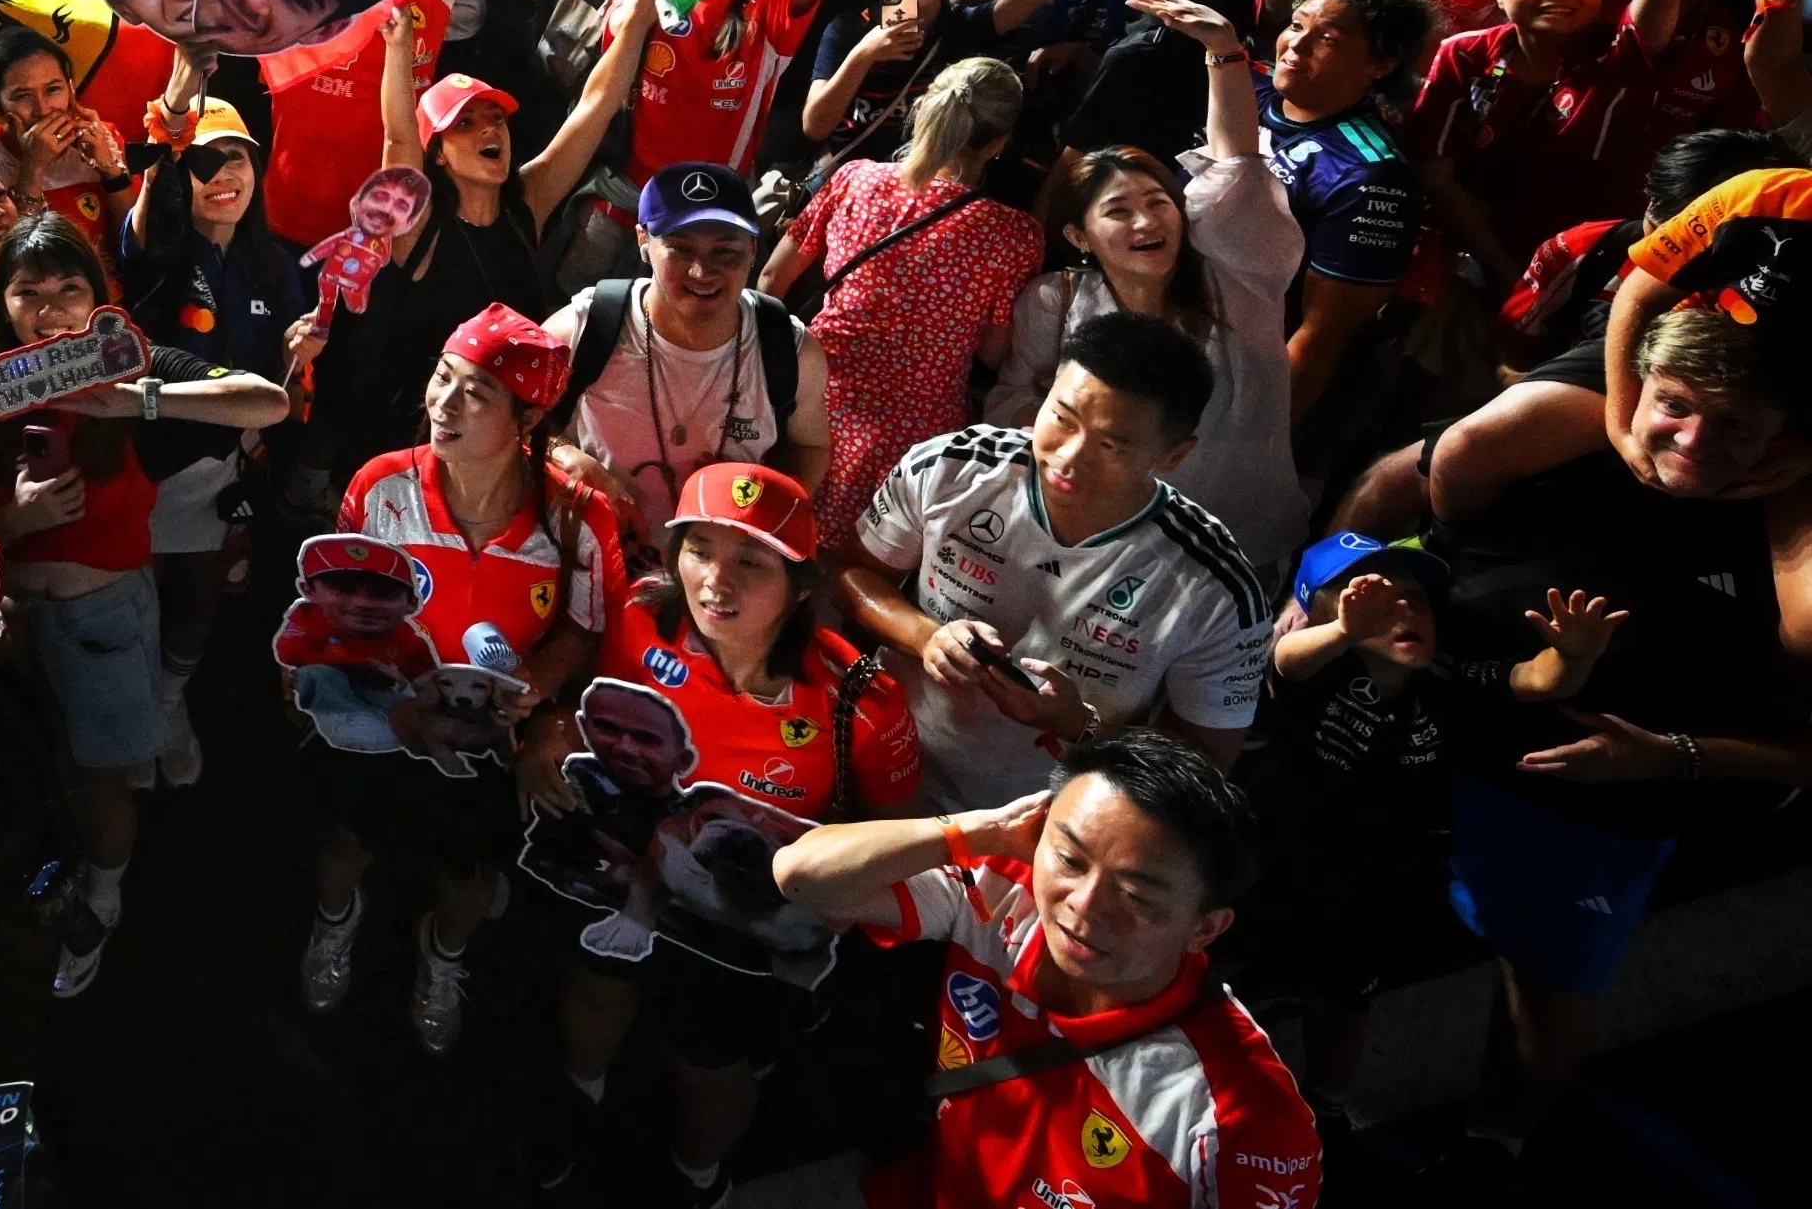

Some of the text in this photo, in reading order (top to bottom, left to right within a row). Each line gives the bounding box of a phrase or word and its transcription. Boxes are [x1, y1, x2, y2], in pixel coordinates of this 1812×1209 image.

[311, 74, 355, 98] IBM
[1368, 185, 1408, 198] SOLERA
[1366, 199, 1398, 214] IWC
[1352, 216, 1405, 230] AKKODIS
[1349, 235, 1399, 249] BONVOY
[958, 555, 999, 586] UBS
[1086, 603, 1140, 627] PETRONAS
[1070, 616, 1141, 655] INEOS
[1072, 643, 1138, 672] TeamViewer
[1066, 659, 1119, 687] HPE
[1346, 713, 1375, 739] UBS
[739, 770, 807, 800] UniCredit
[952, 978, 999, 1031] hp
[1236, 1152, 1312, 1179] ambipar
